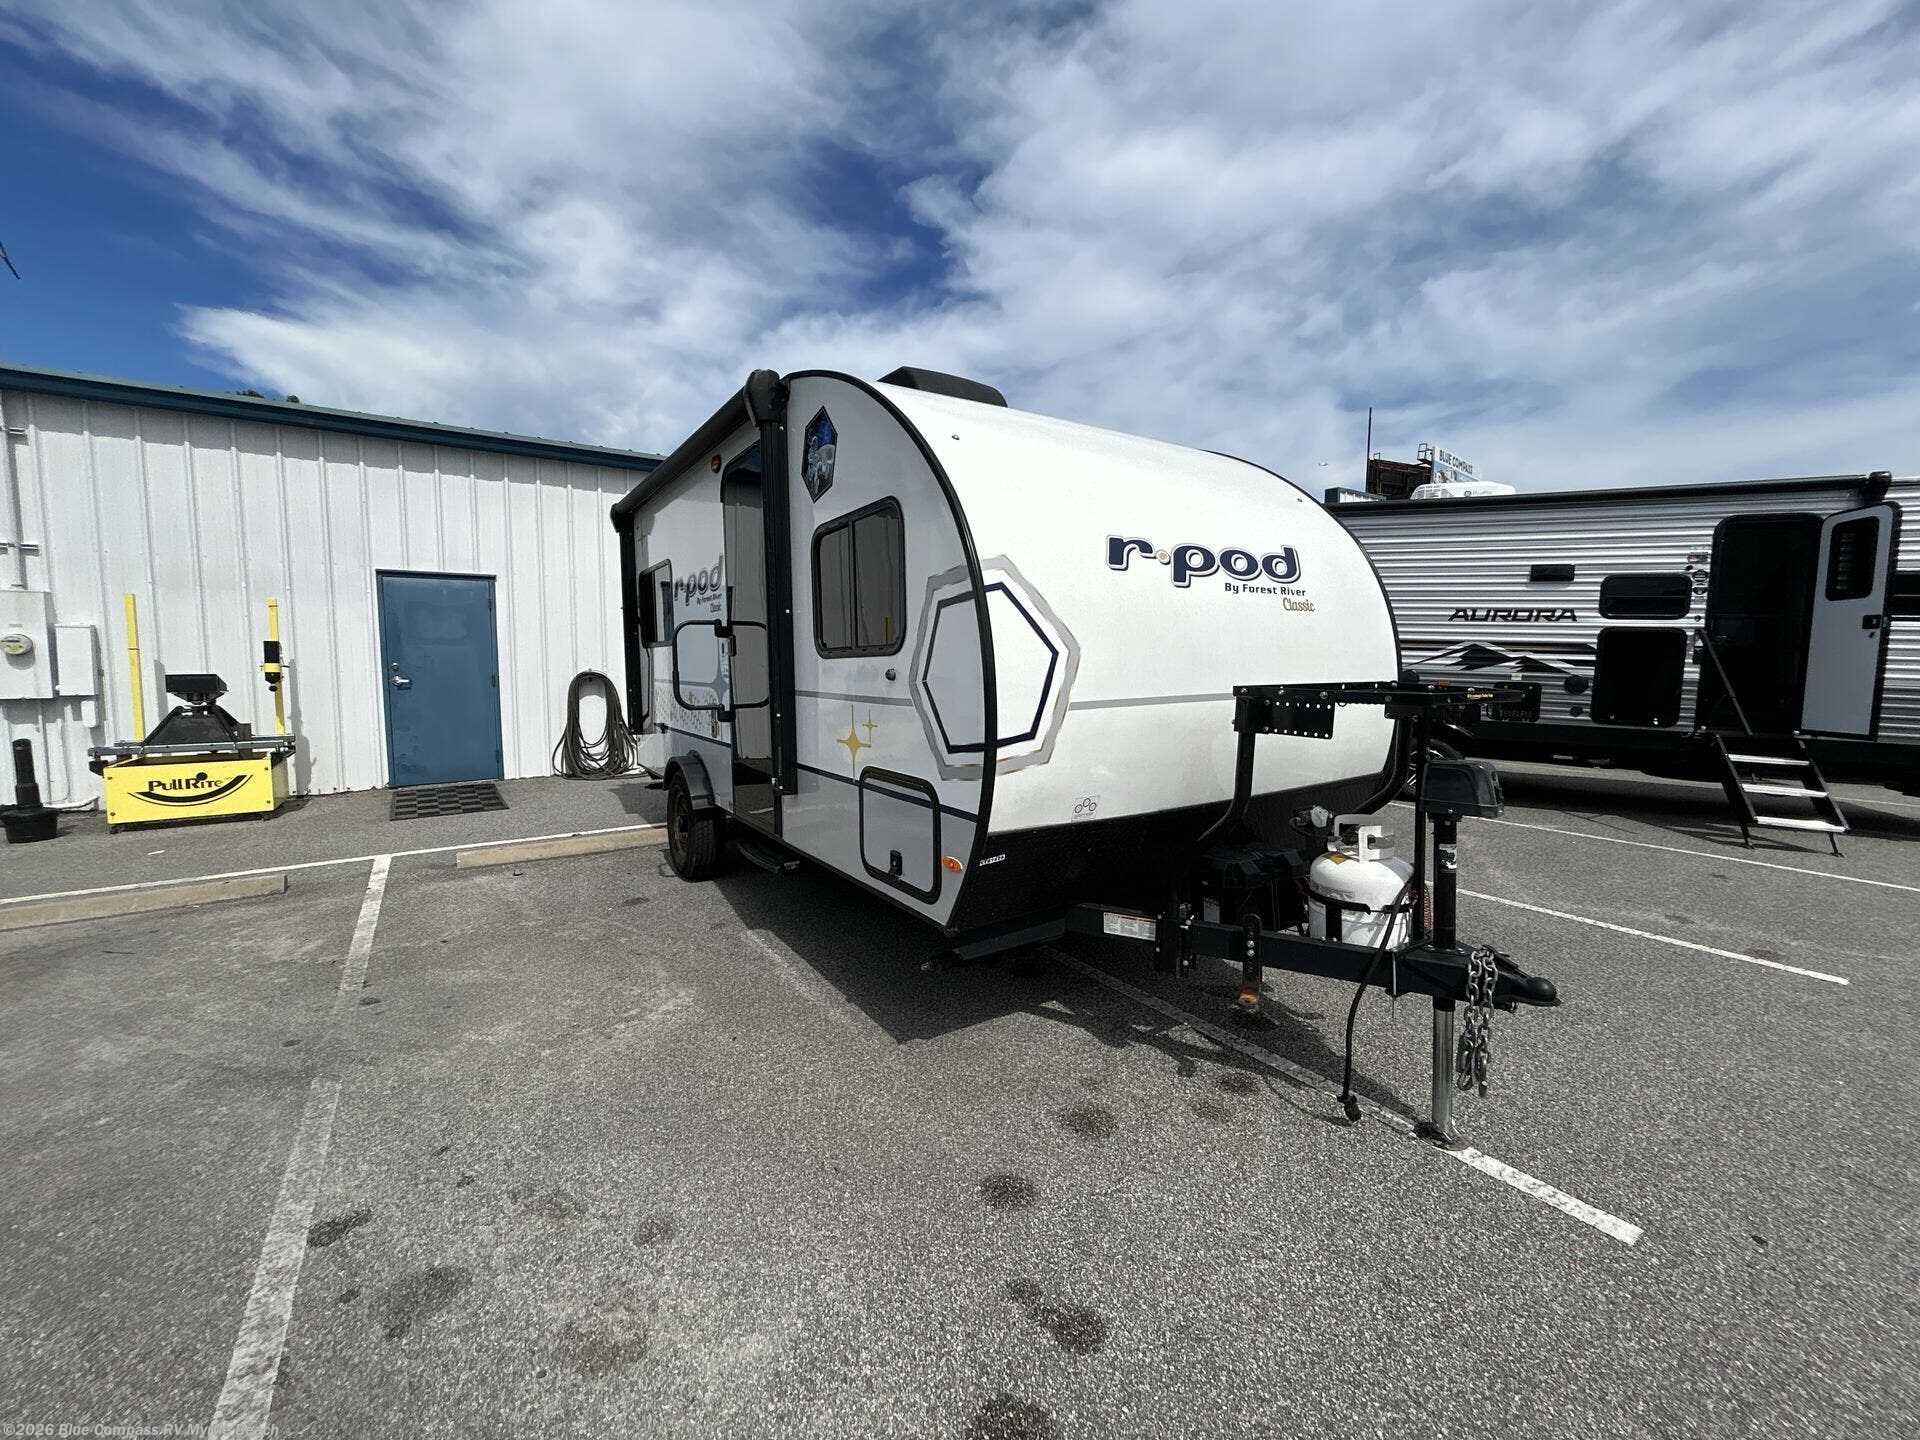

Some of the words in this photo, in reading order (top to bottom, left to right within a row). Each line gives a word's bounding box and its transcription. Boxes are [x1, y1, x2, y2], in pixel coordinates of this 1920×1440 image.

[1439, 449, 1452, 465] BLUE
[1452, 456, 1473, 475] COMPASS
[1224, 582, 1239, 594] By
[1242, 583, 1278, 595] Forest
[1280, 586, 1307, 597] River
[1282, 597, 1316, 612] Classic
[1447, 608, 1578, 622] AURORA
